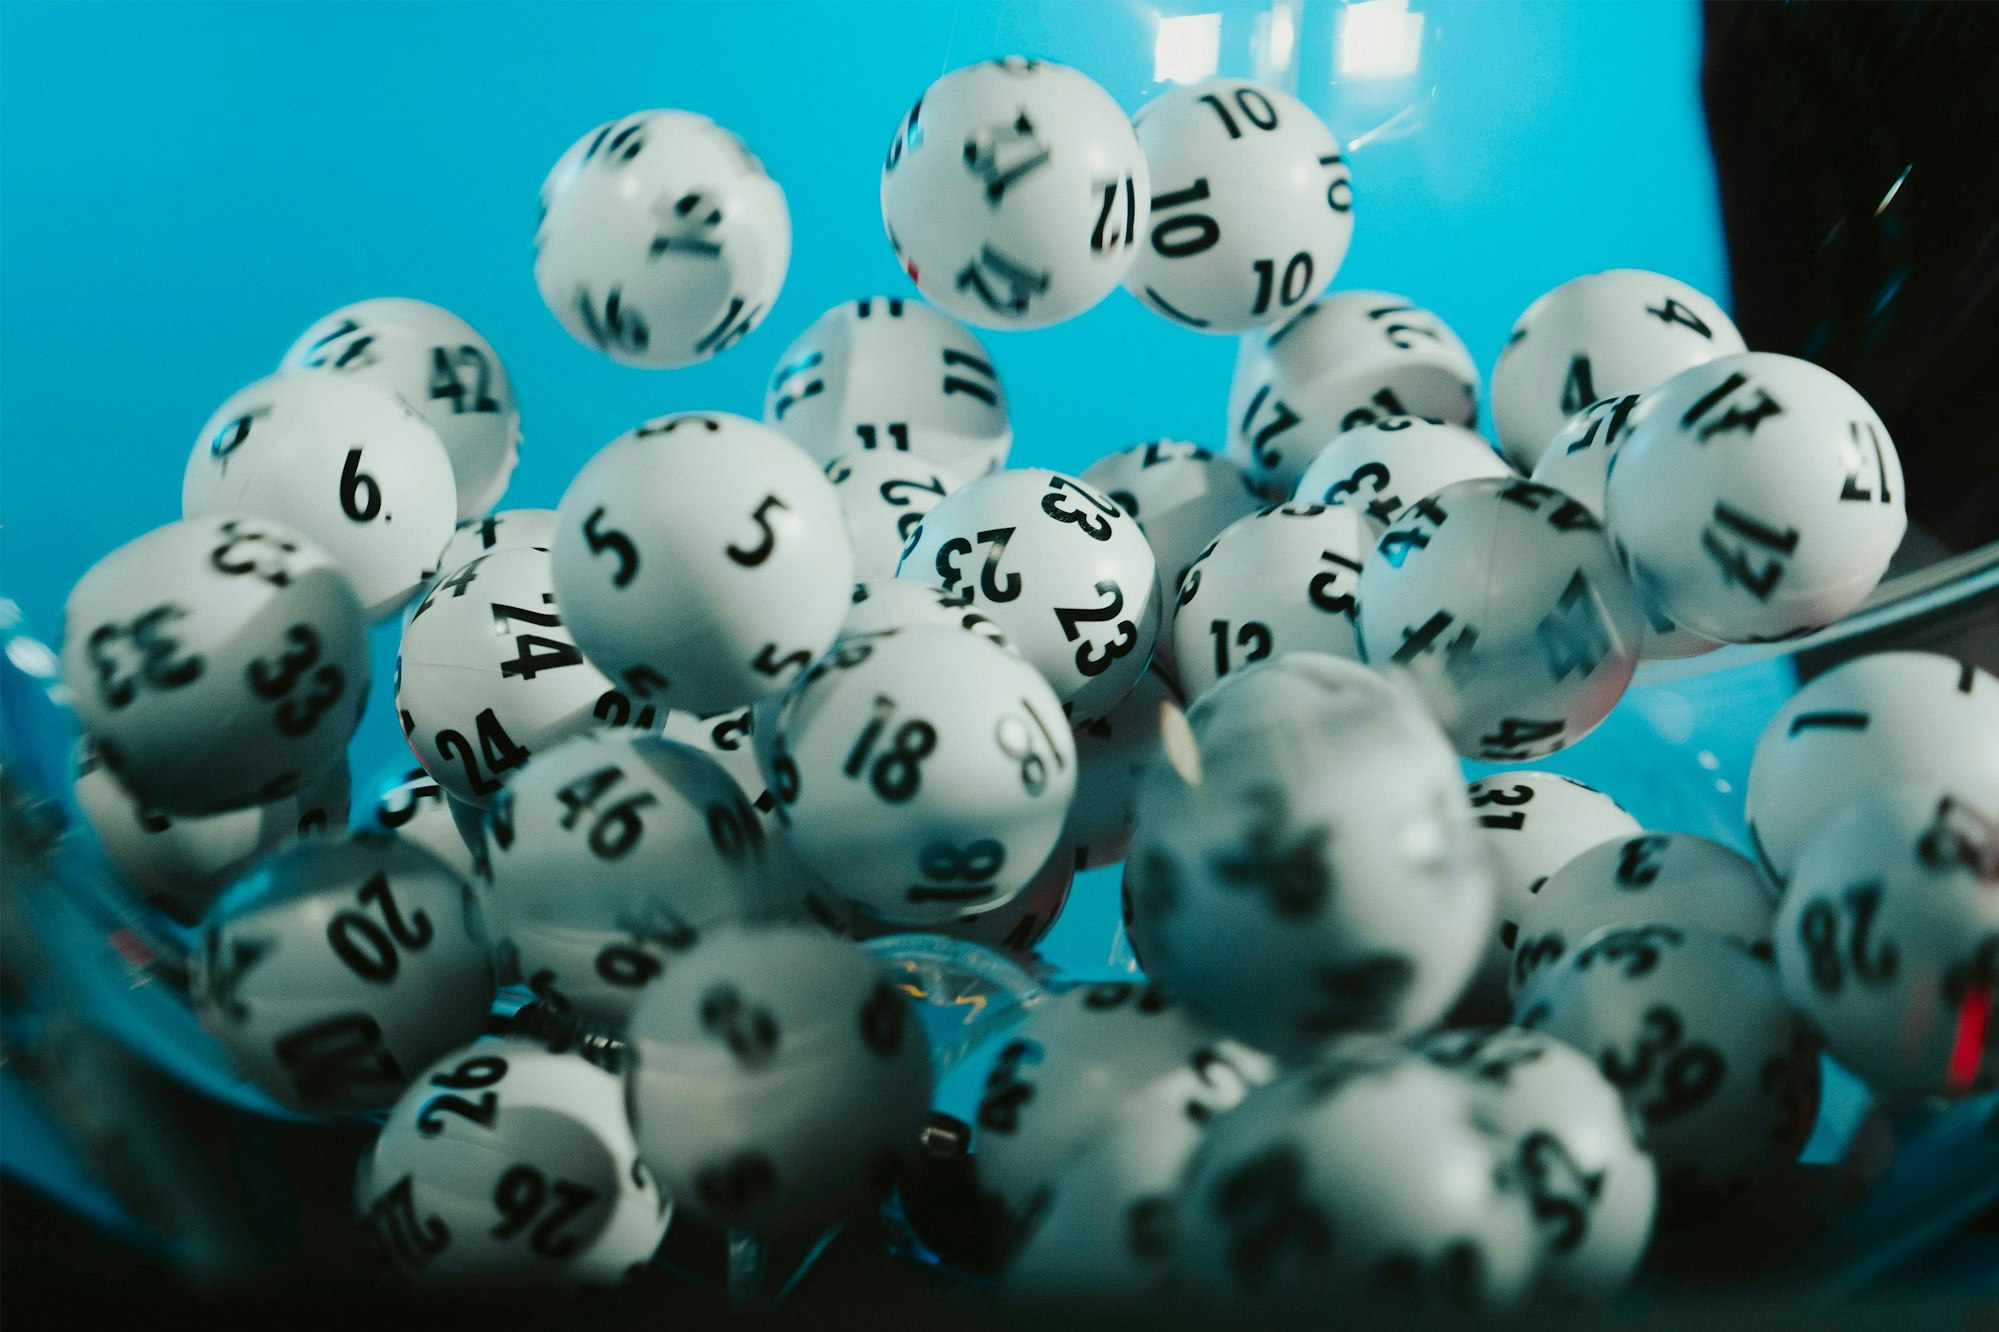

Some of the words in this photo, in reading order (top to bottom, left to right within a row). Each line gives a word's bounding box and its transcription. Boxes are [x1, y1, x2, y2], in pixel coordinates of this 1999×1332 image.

[1199, 88, 1279, 140] 10
[1150, 177, 1221, 259] 10
[1251, 251, 1315, 316] 10
[1646, 297, 1713, 340] 4
[429, 343, 500, 416] 42
[942, 347, 1000, 408] 11
[581, 501, 643, 592] 5
[725, 493, 792, 569] 5
[1040, 475, 1122, 542] 23
[1701, 499, 1799, 601] 17
[935, 525, 1023, 606] 23
[491, 592, 585, 682] 24
[1052, 576, 1138, 678] 23
[246, 623, 344, 738] 33
[434, 707, 532, 799] 24
[841, 691, 940, 806] 18
[555, 763, 661, 862] 46
[907, 837, 1008, 904] 18
[326, 874, 435, 985] 20
[416, 1056, 509, 1139] 26
[1601, 1003, 1724, 1124] 39
[489, 1162, 600, 1260] 26
